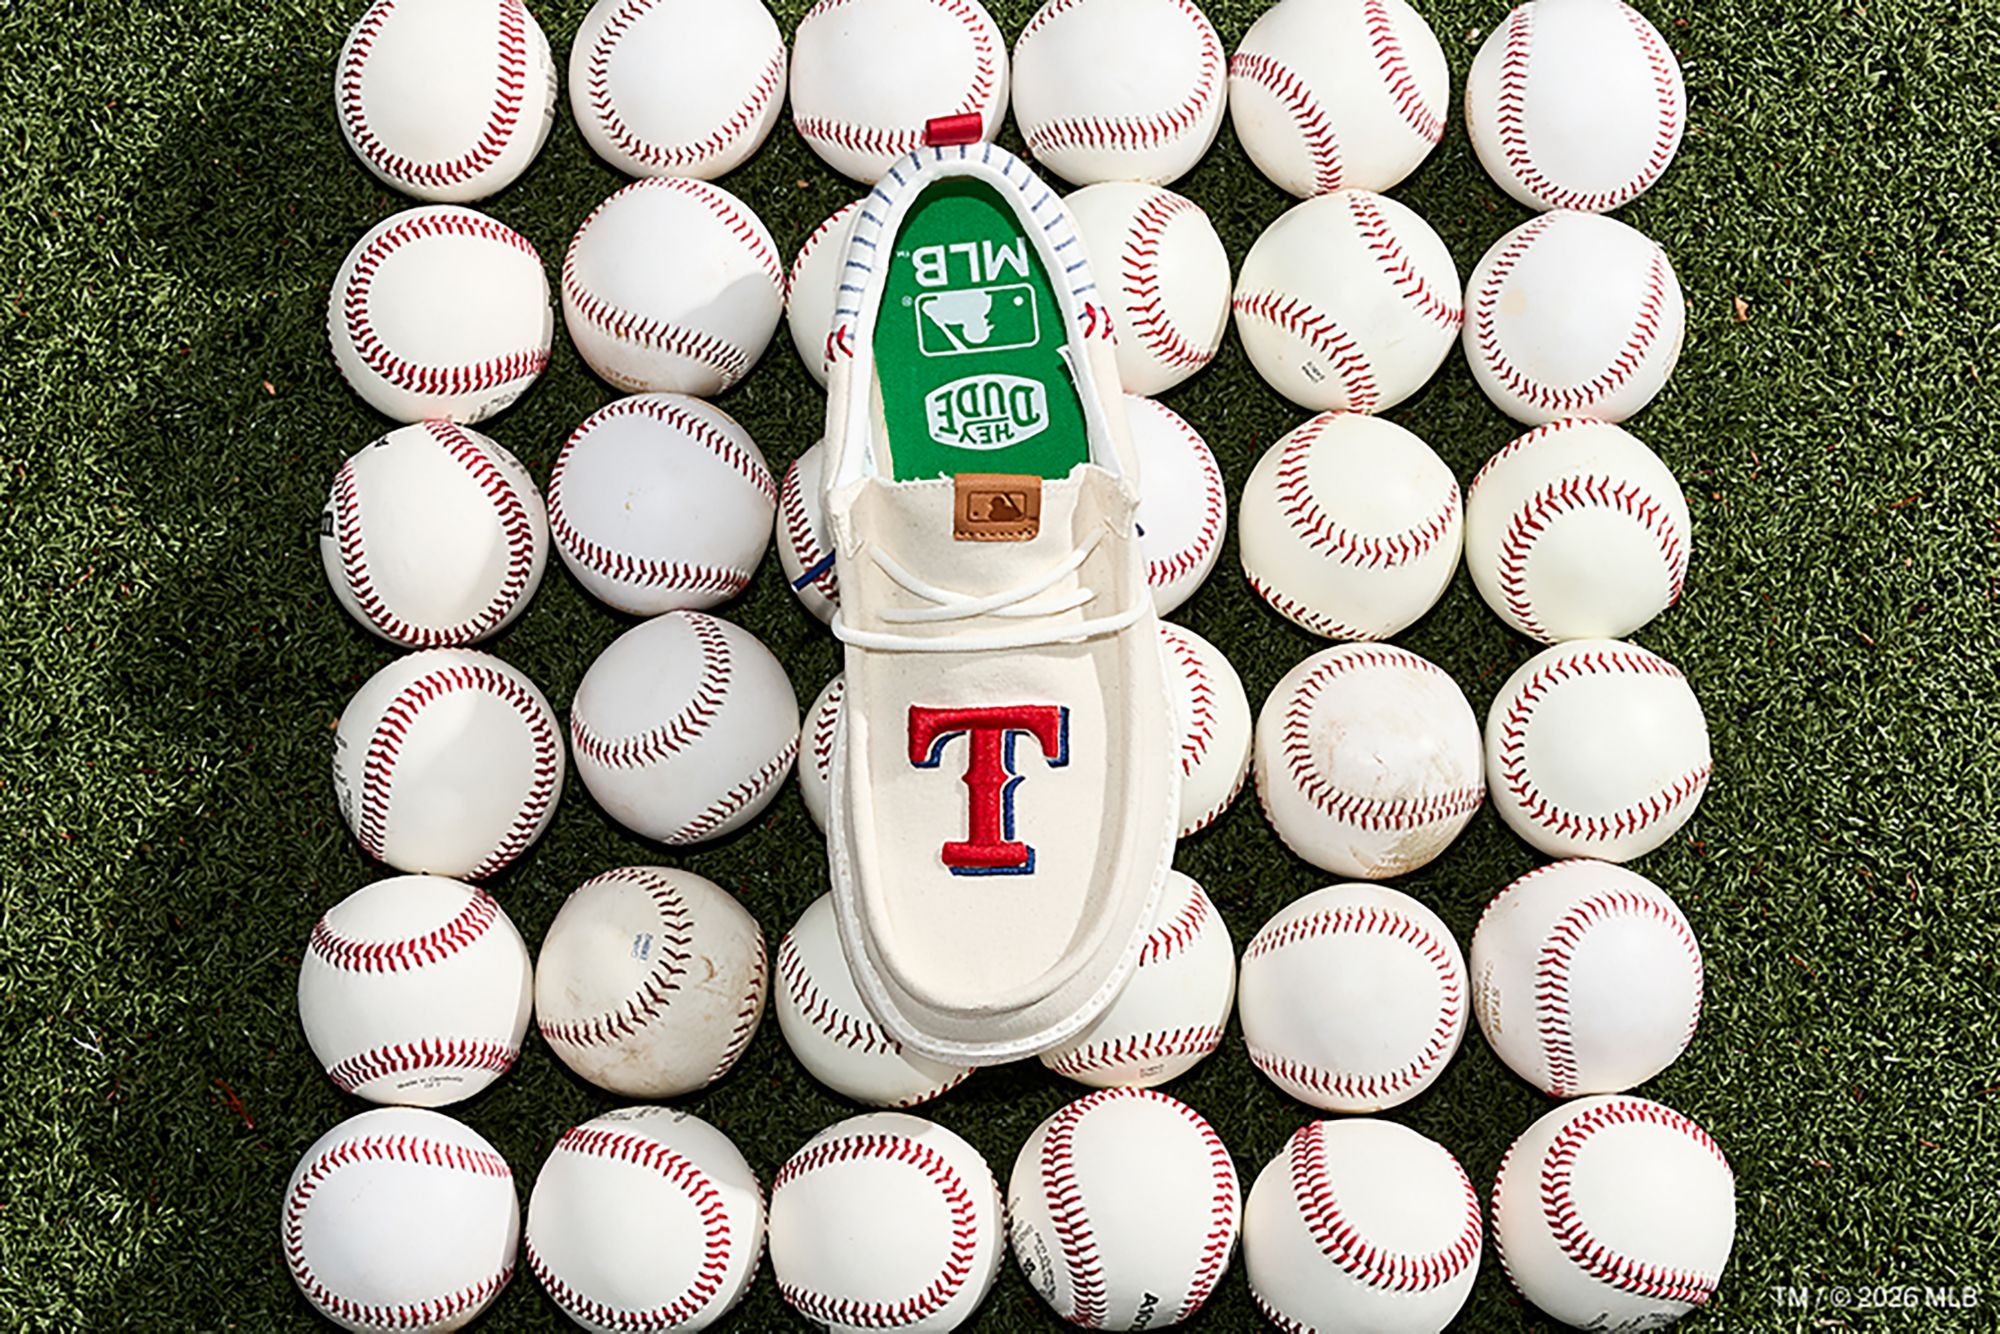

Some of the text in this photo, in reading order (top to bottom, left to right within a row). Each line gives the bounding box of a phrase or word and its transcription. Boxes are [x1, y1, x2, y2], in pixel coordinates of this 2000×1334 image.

[912, 237, 1030, 287] MLB
[934, 381, 1041, 435] DUDE
[958, 416, 1015, 444] HEY
[907, 704, 1070, 876] T
